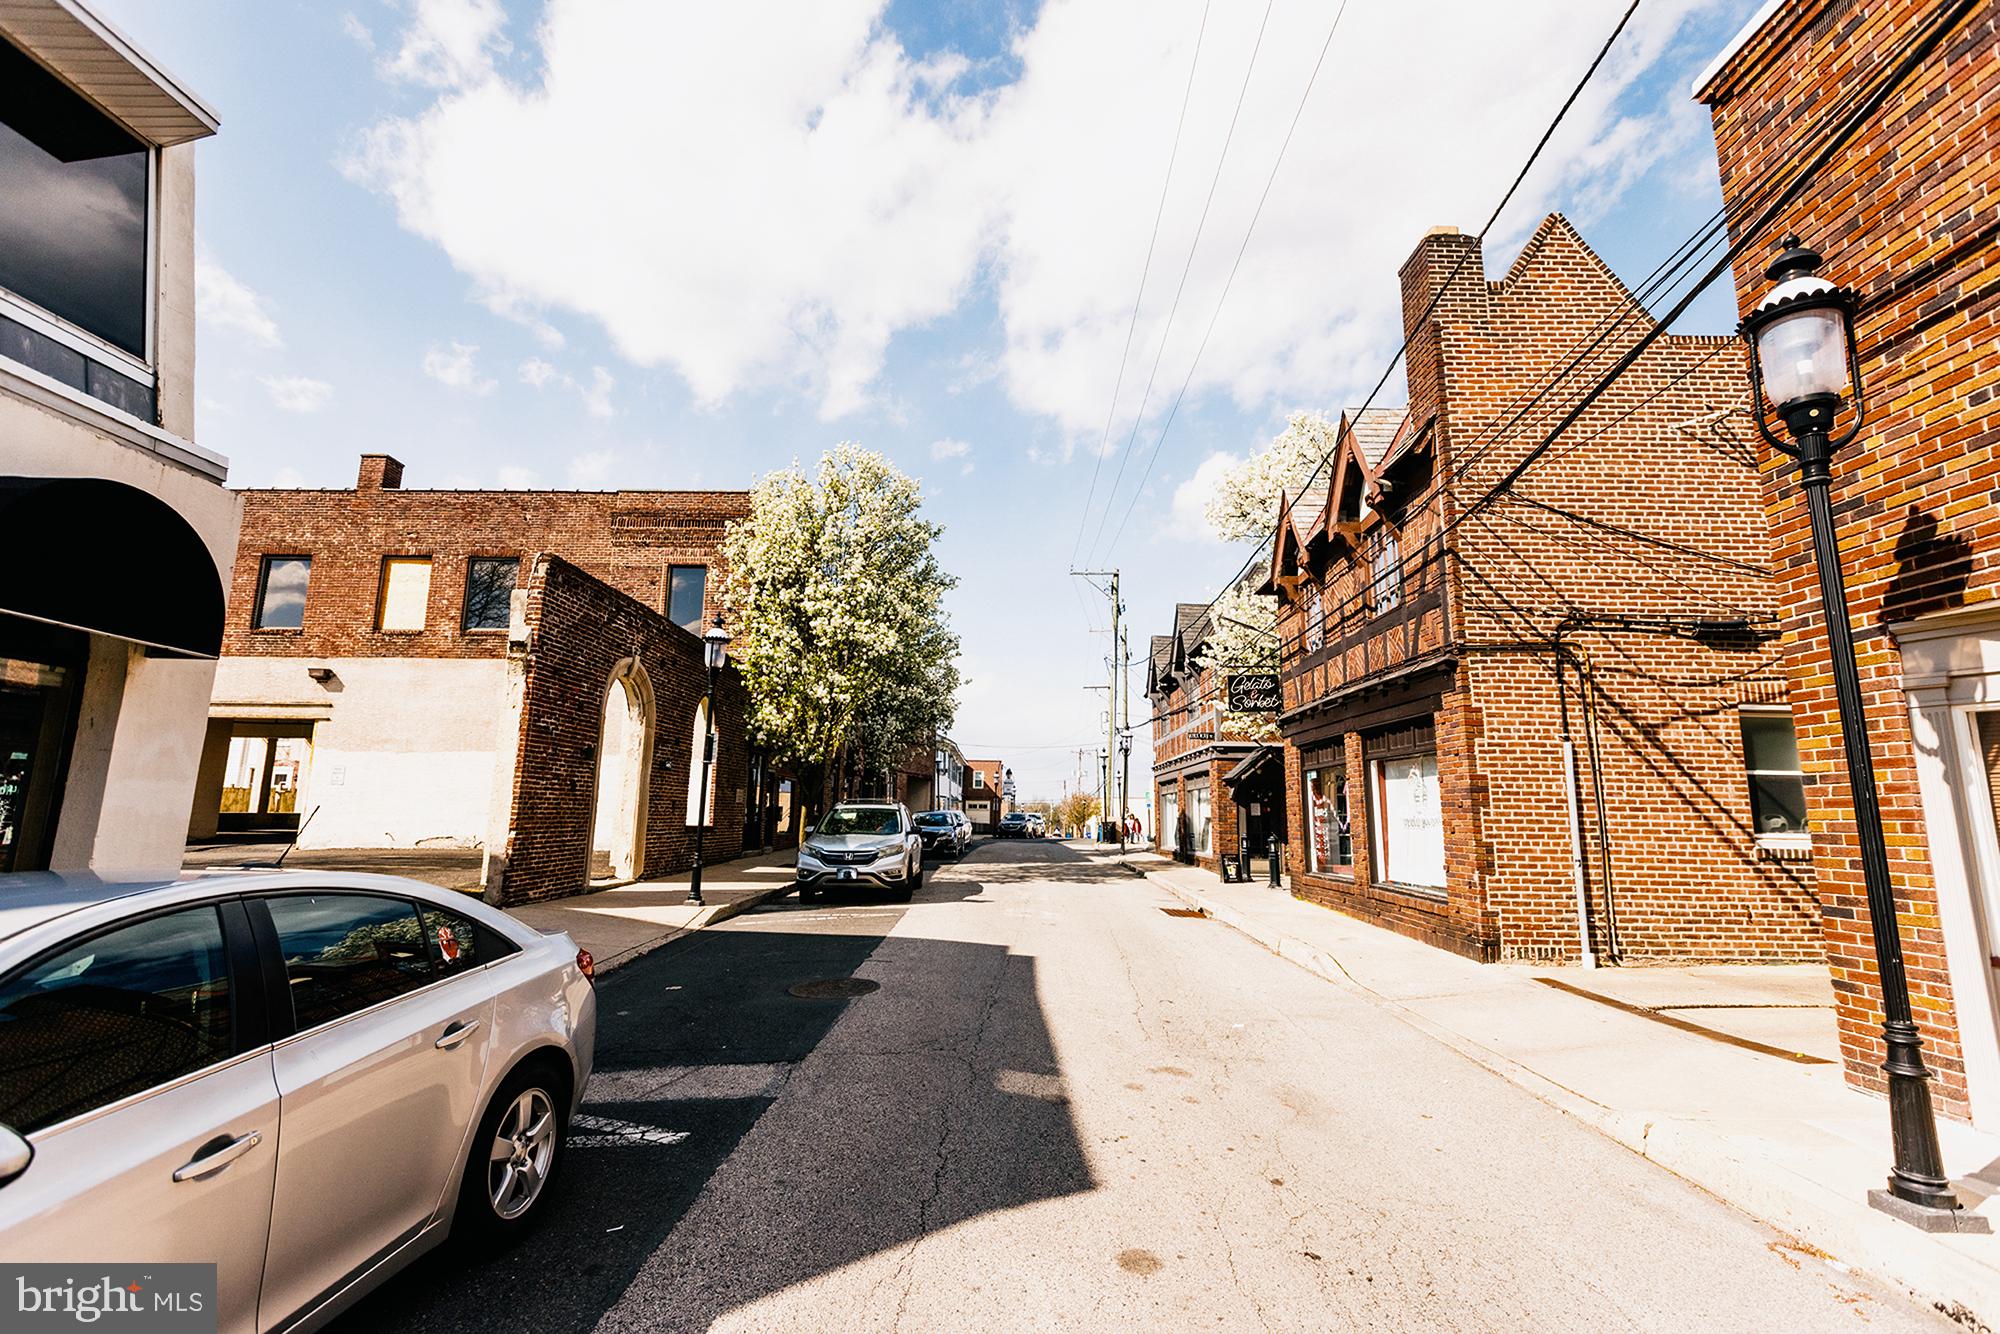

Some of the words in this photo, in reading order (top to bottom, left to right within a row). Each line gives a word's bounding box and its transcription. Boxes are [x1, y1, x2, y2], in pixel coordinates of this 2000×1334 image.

[1231, 675, 1276, 694] Gelato
[1230, 694, 1280, 712] Sorbet
[1250, 690, 1260, 699] &
